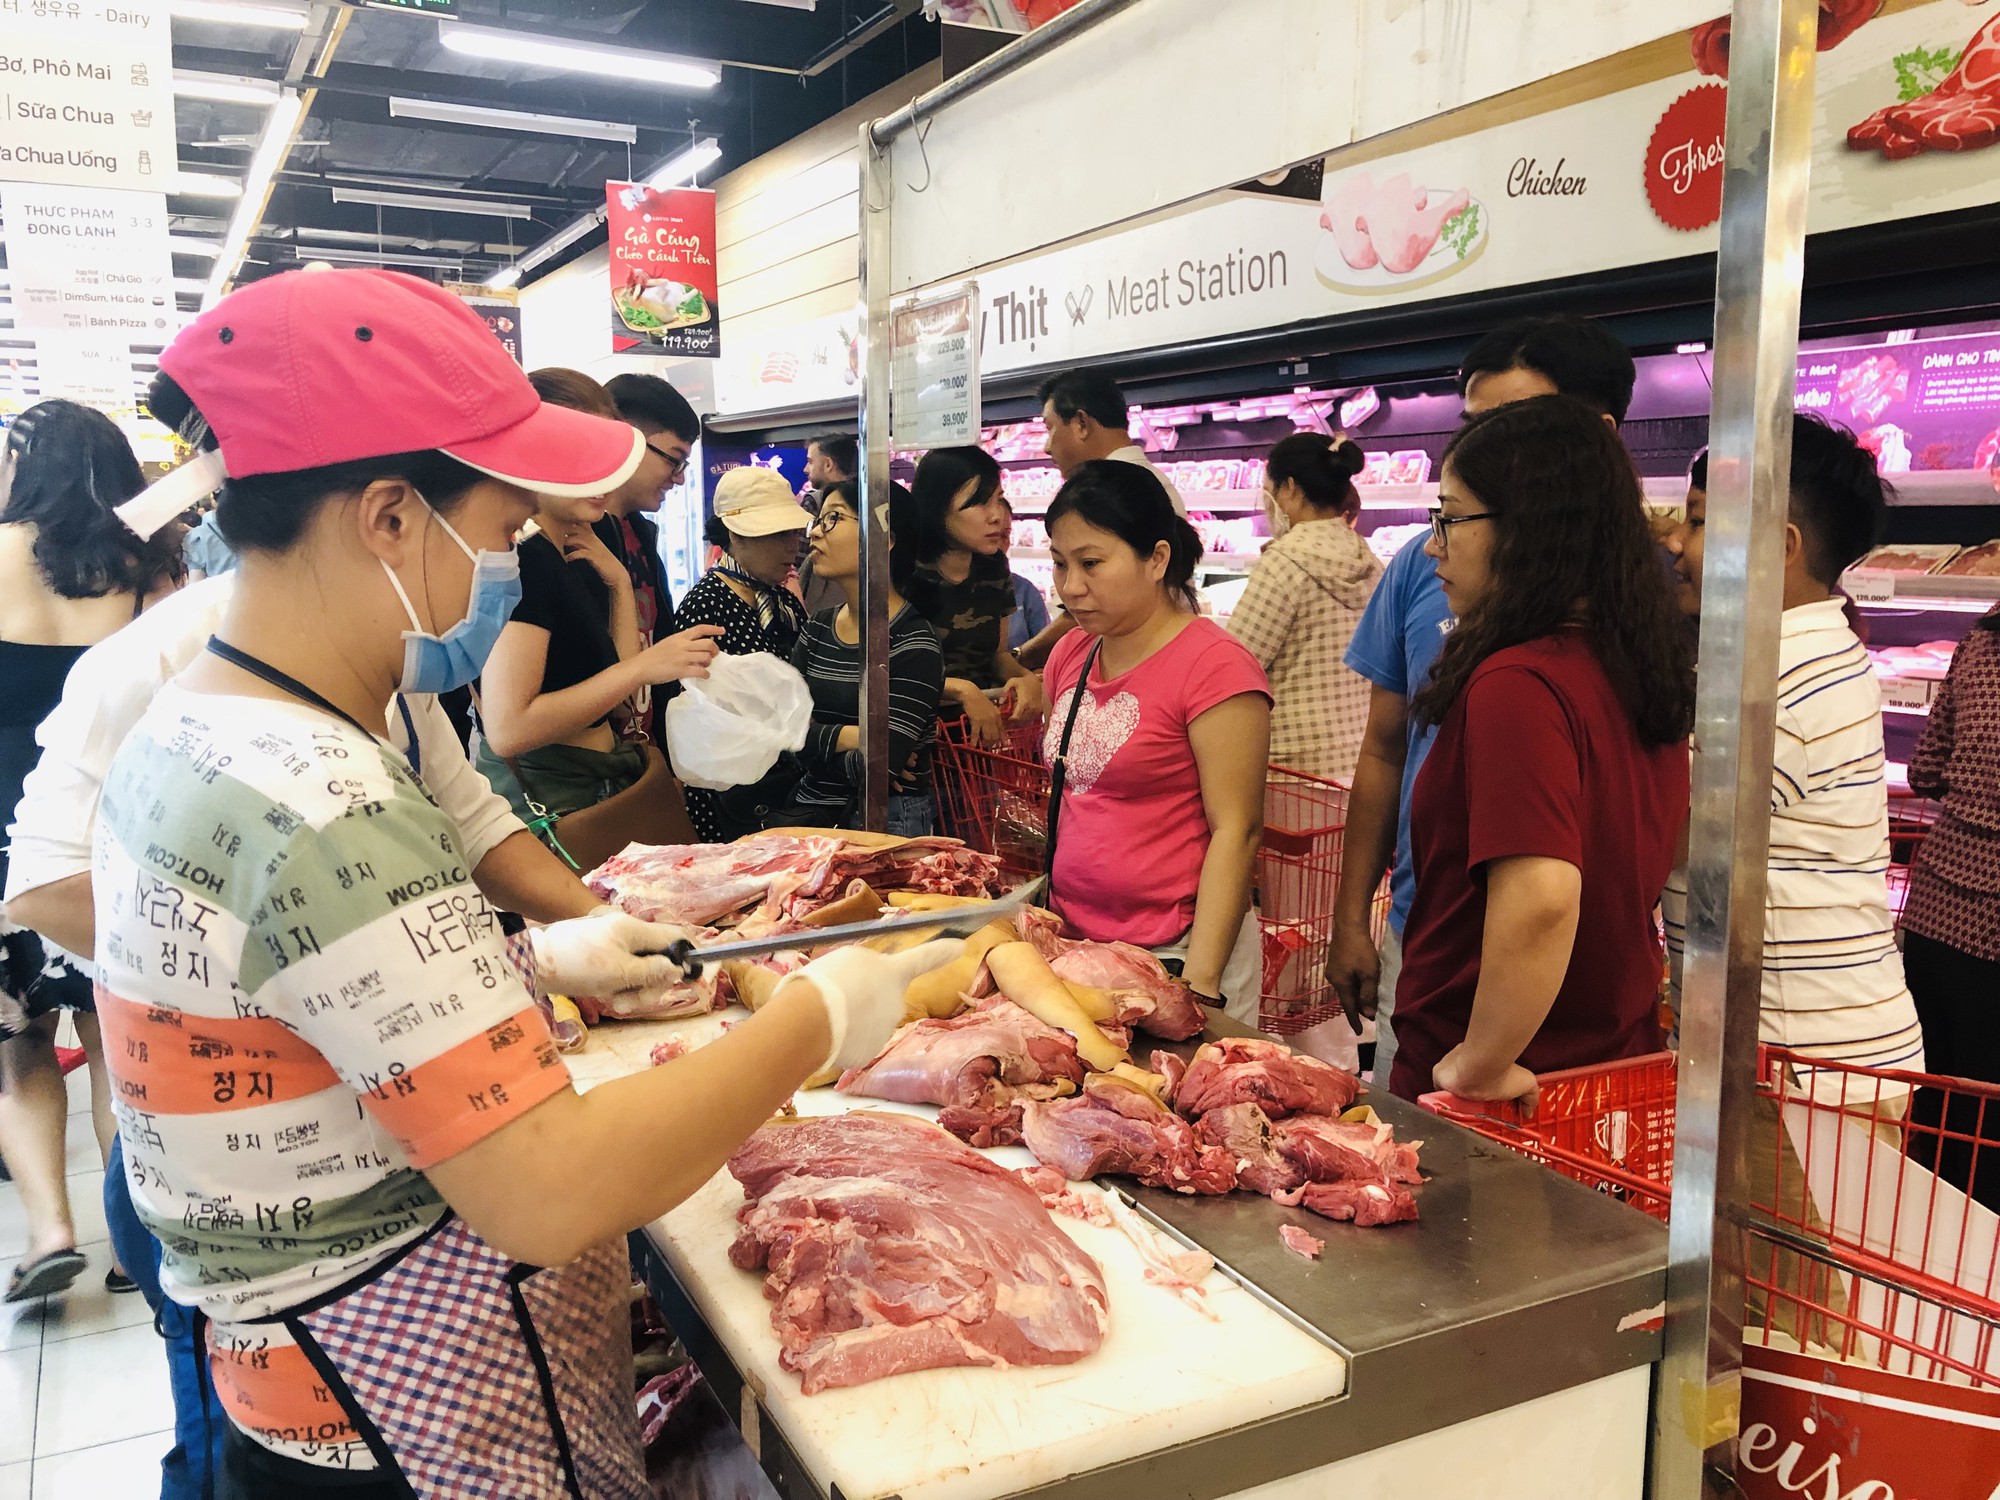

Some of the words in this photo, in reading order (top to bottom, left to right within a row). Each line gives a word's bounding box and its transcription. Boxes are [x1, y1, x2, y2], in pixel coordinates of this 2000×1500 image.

[106, 9, 150, 28] Dairy
[33, 59, 71, 77] Phô
[77, 62, 111, 80] Mai
[17, 102, 56, 120] Sữa
[62, 106, 114, 125] Chua
[16, 147, 64, 165] Chua
[68, 150, 117, 172] Uống
[1660, 135, 1724, 194] Fres
[1507, 157, 1587, 198] Chicken
[624, 226, 651, 246] Gà
[656, 228, 700, 253] Cúng
[647, 249, 680, 263] Cánh
[681, 249, 711, 266] Tiên
[65, 292, 108, 303] DimSum,
[993, 285, 1048, 352] Thịt
[1107, 268, 1170, 320] Meat
[1177, 248, 1287, 306] Station
[119, 319, 147, 328] Pizza
[1809, 363, 1837, 376] Mart
[1956, 351, 1980, 366] CHO
[144, 842, 226, 895] HOT.COM
[386, 866, 468, 907] OT.COM
[161, 942, 209, 988] 정지
[213, 1071, 273, 1103] 정지
[226, 1133, 261, 1152] 정지
[131, 1155, 172, 1195] 정지
[318, 1212, 420, 1259] HOT.CO
